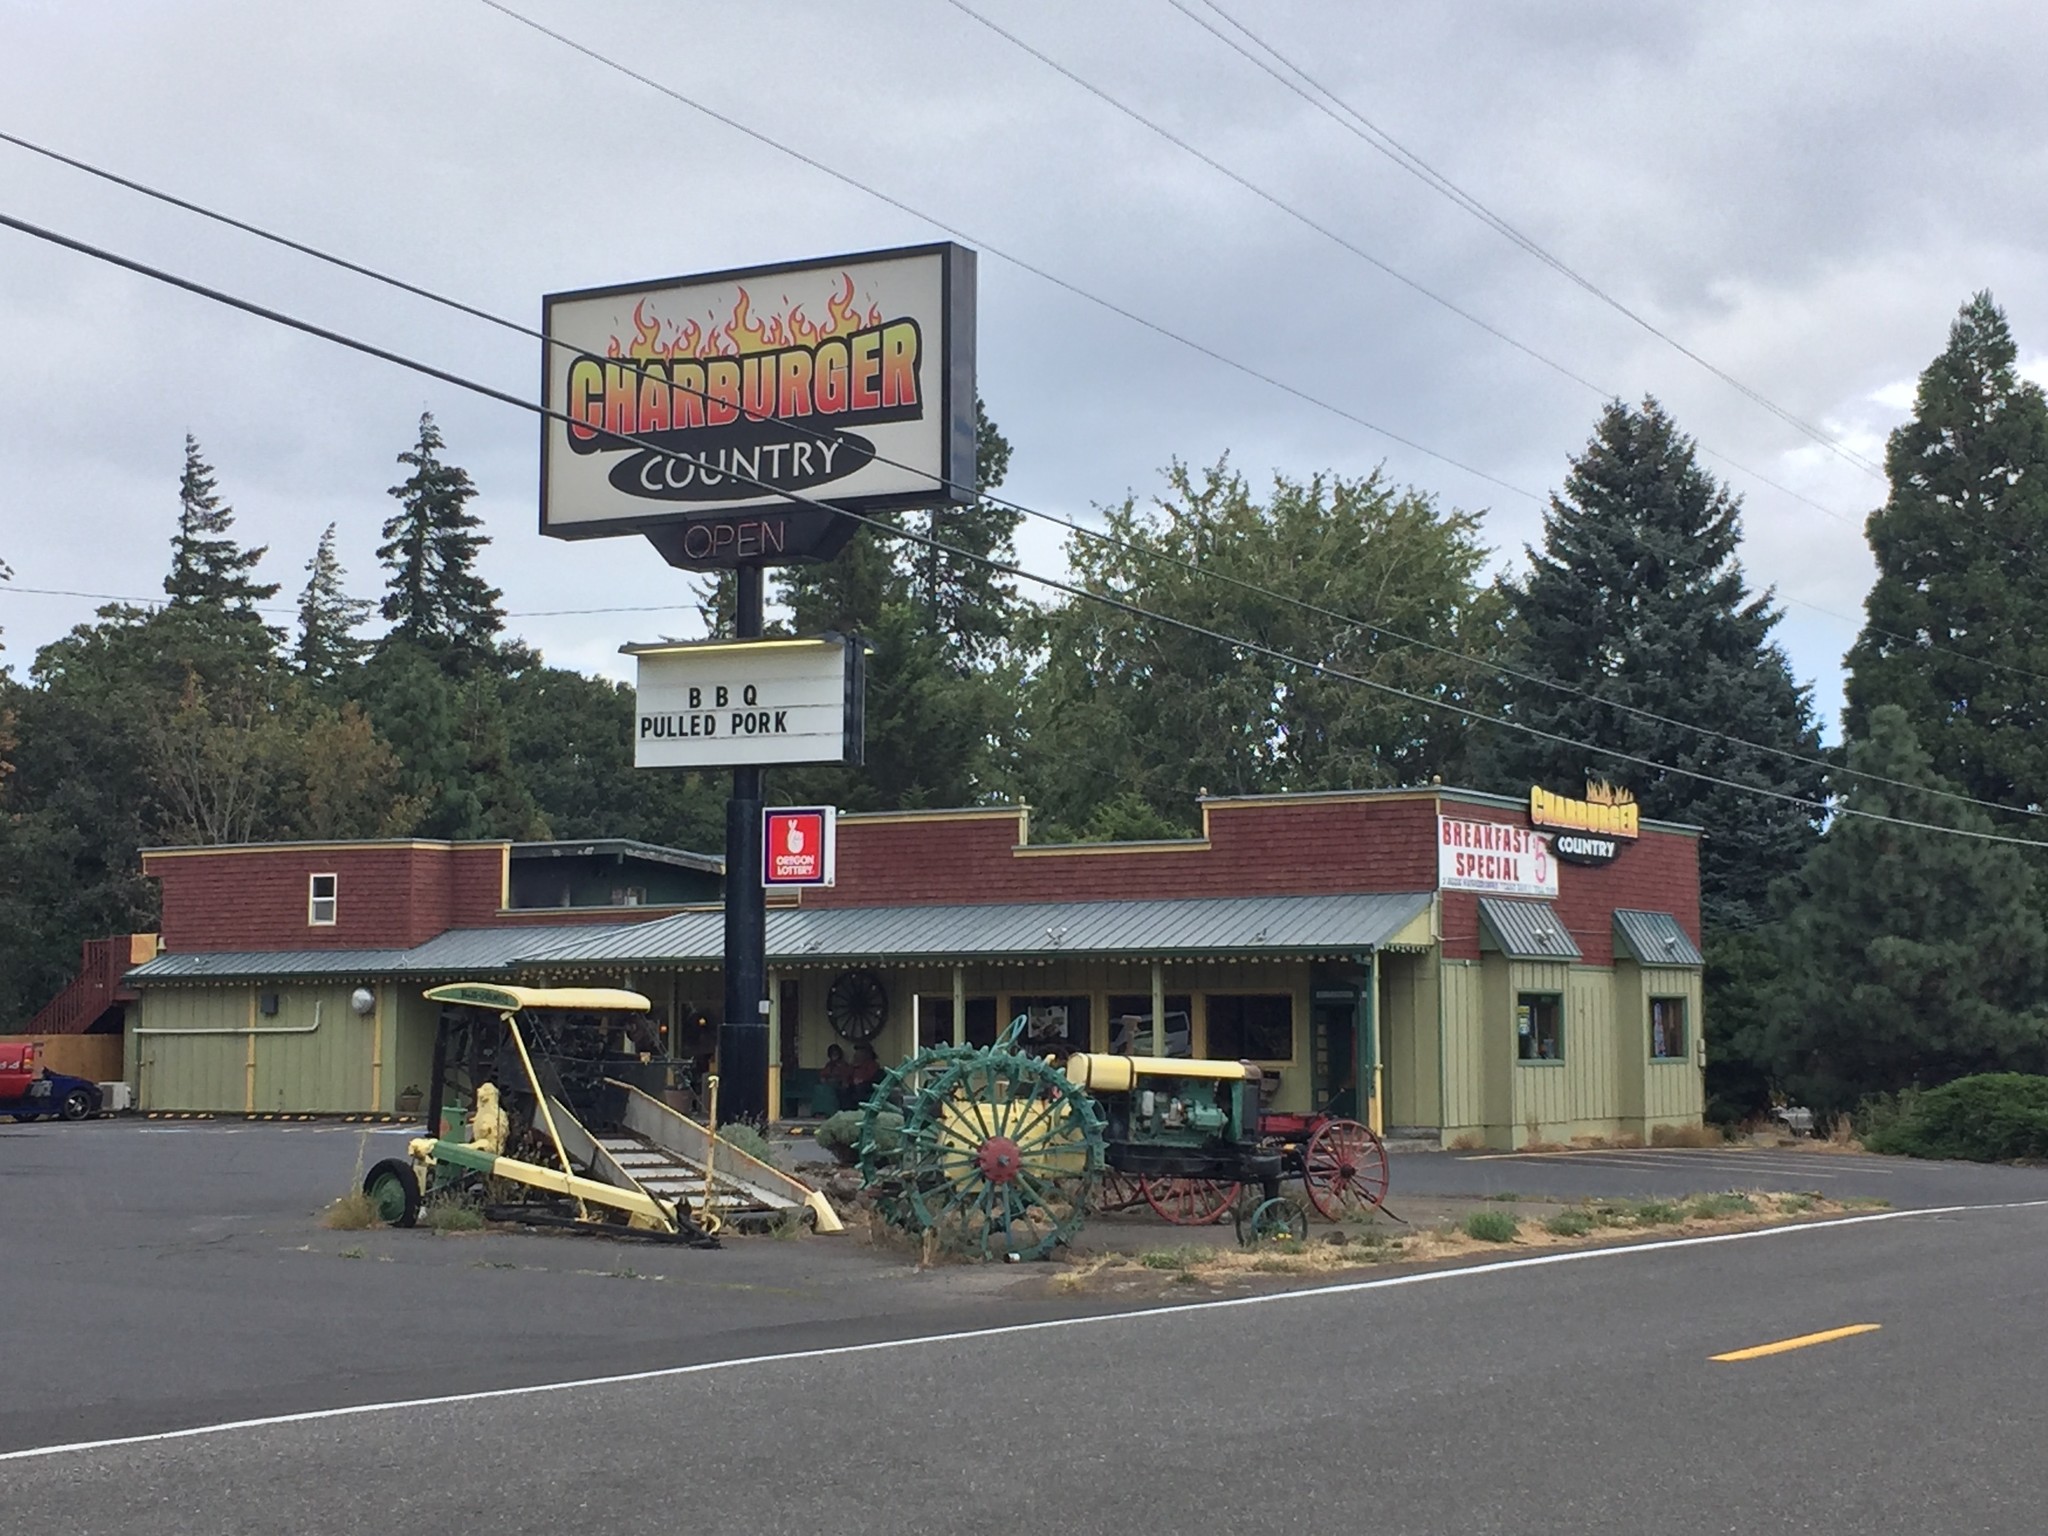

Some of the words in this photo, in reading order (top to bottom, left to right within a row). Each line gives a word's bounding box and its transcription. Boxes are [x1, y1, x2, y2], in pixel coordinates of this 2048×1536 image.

[570, 323, 918, 441] CHARBURGER
[640, 437, 844, 490] COUNTRY
[684, 520, 785, 559] OPEN
[641, 714, 716, 738] PULLED
[731, 711, 788, 735] PORK
[1442, 821, 1531, 854] BREAKFAST
[1557, 836, 1615, 858] COUNTRY
[776, 854, 815, 866] OREGON
[1456, 852, 1520, 882] SPECIAL
